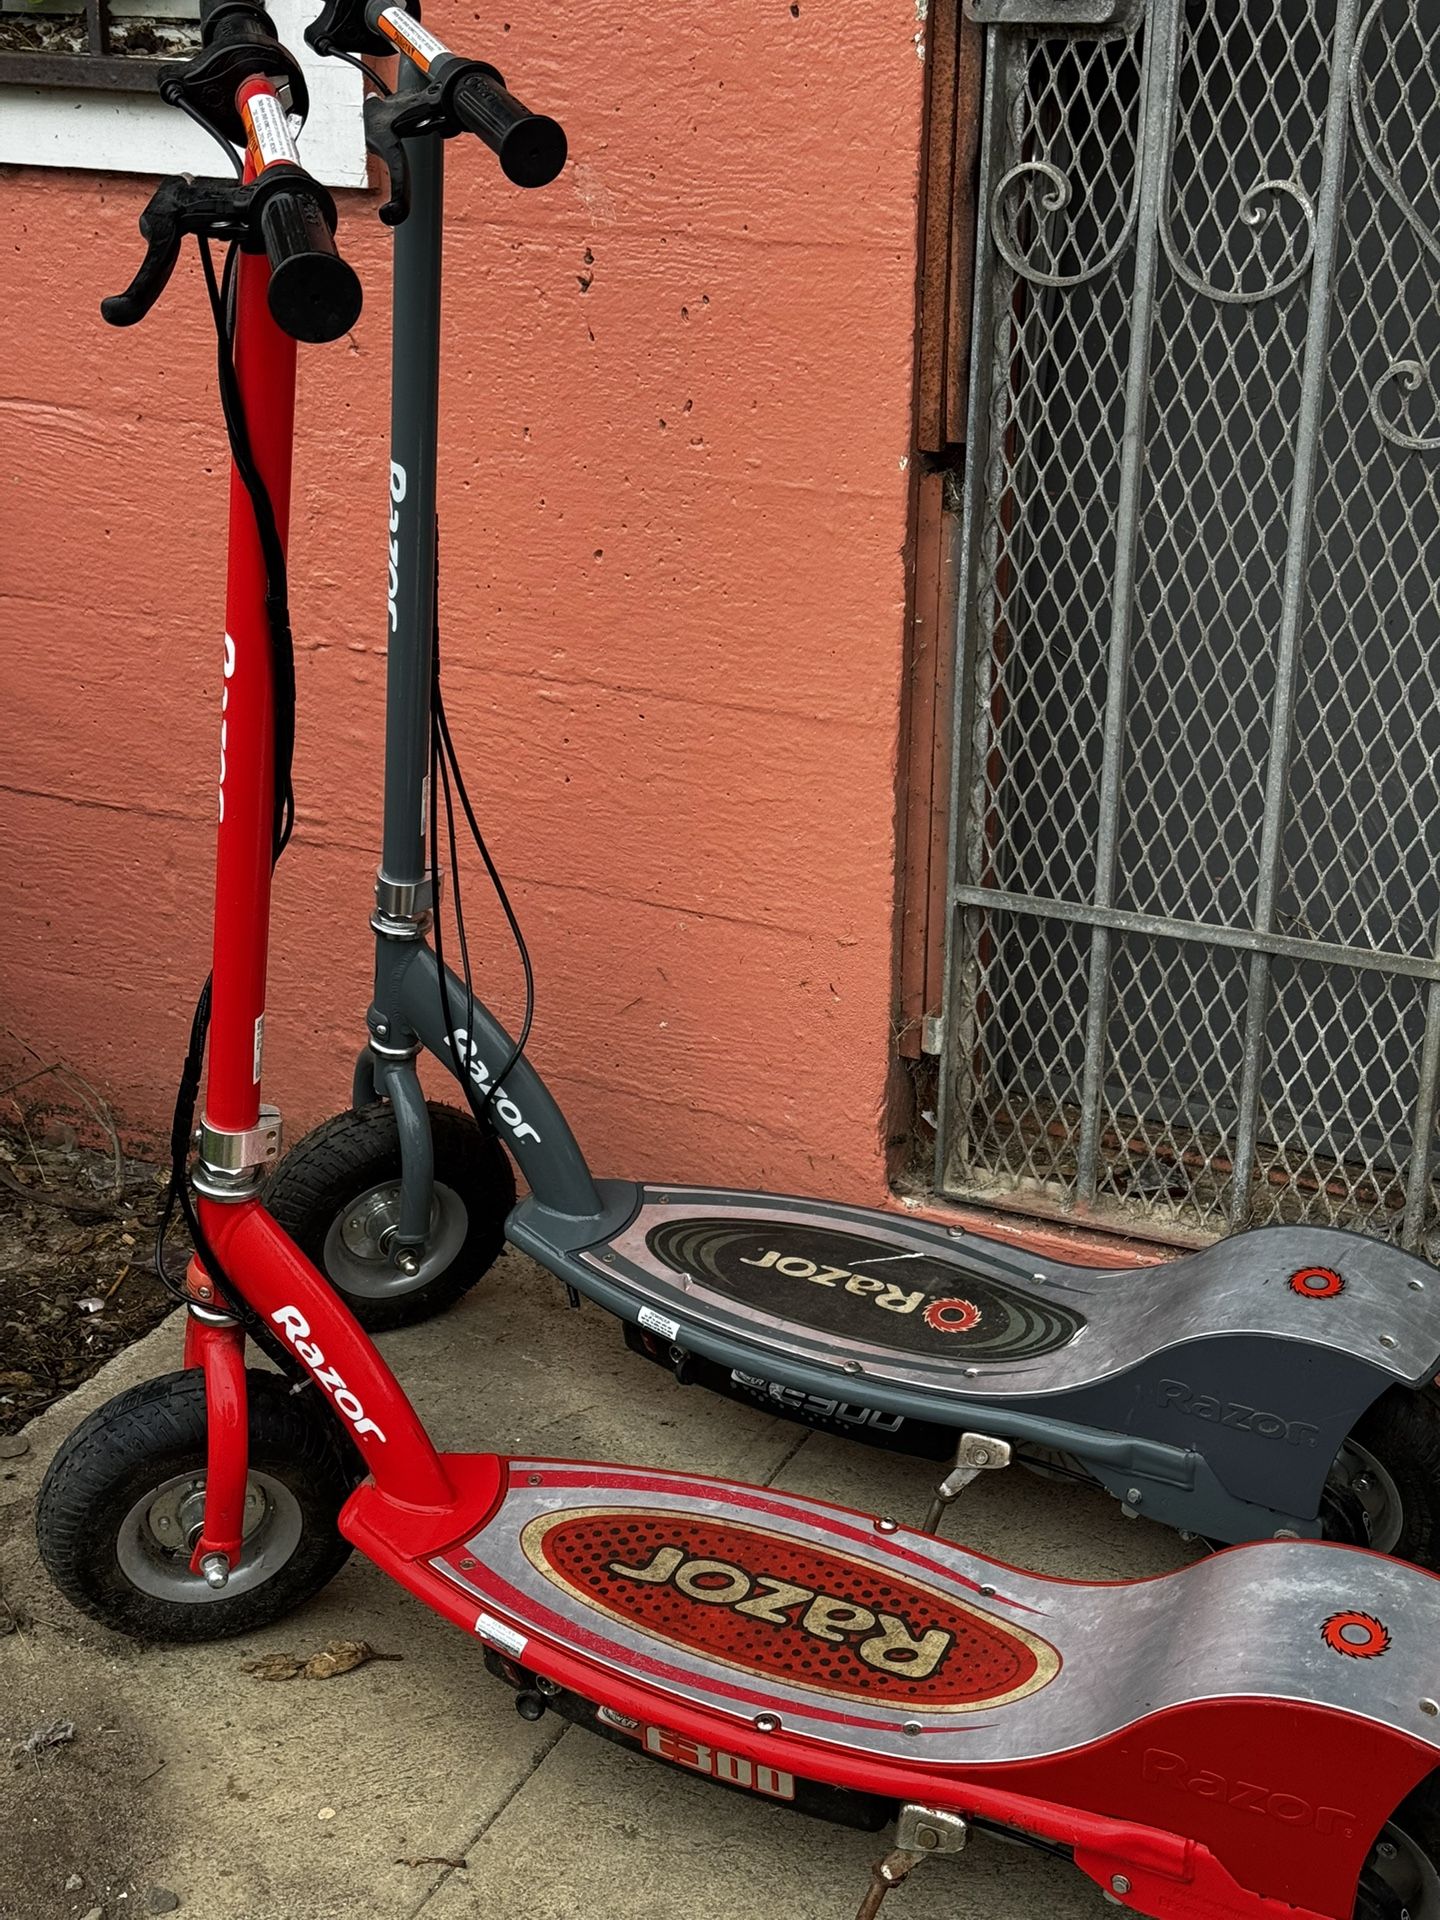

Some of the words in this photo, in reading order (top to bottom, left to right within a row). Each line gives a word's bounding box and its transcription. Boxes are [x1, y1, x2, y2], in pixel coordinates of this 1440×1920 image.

[739, 1250, 926, 1314] Razor
[271, 1305, 387, 1443] Razor
[1157, 1378, 1319, 1446] Razor
[608, 1545, 952, 1679] Razor
[646, 1725, 795, 1800] E300
[1142, 1747, 1357, 1835] Razor
